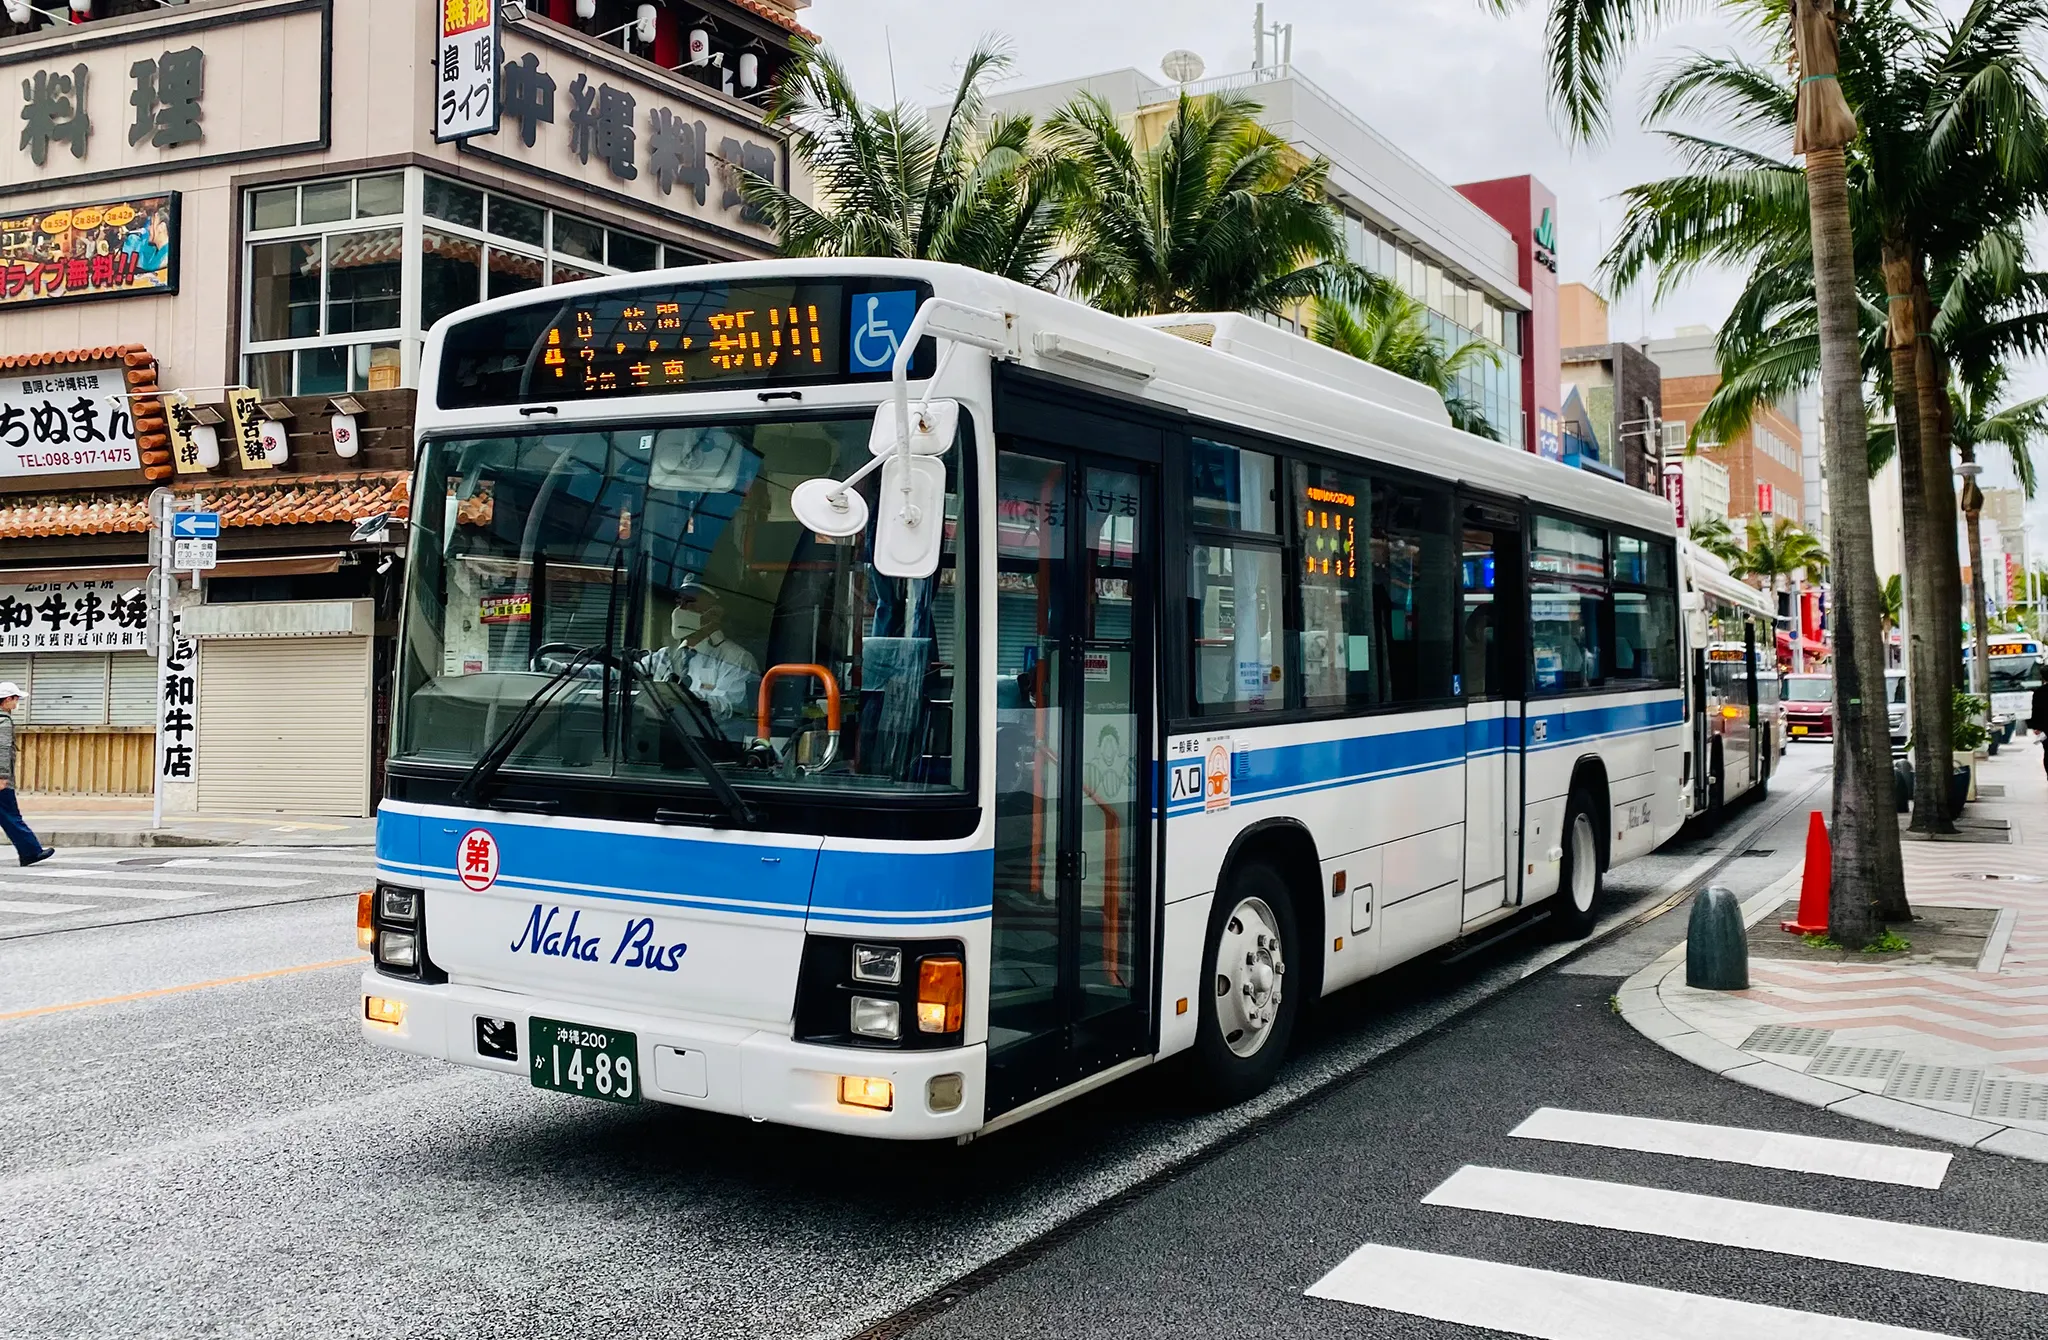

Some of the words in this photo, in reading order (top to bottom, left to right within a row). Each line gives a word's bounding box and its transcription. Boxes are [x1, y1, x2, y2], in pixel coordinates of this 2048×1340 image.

[443, 35, 490, 82] 島唄
[19, 45, 205, 166] 料理
[442, 78, 491, 125] ライブ
[499, 52, 776, 230] 沖縄料理
[708, 303, 821, 370] 新川
[22, 375, 99, 394] 島唄と沖縄料理
[0, 396, 136, 447] ちぬまん
[18, 449, 131, 468] TEL:098-917-1475
[1172, 767, 1201, 798] 入口
[510, 904, 600, 962] Naha
[610, 917, 688, 972] Bus
[534, 1054, 546, 1069] か
[552, 1044, 633, 1098] 14-89
